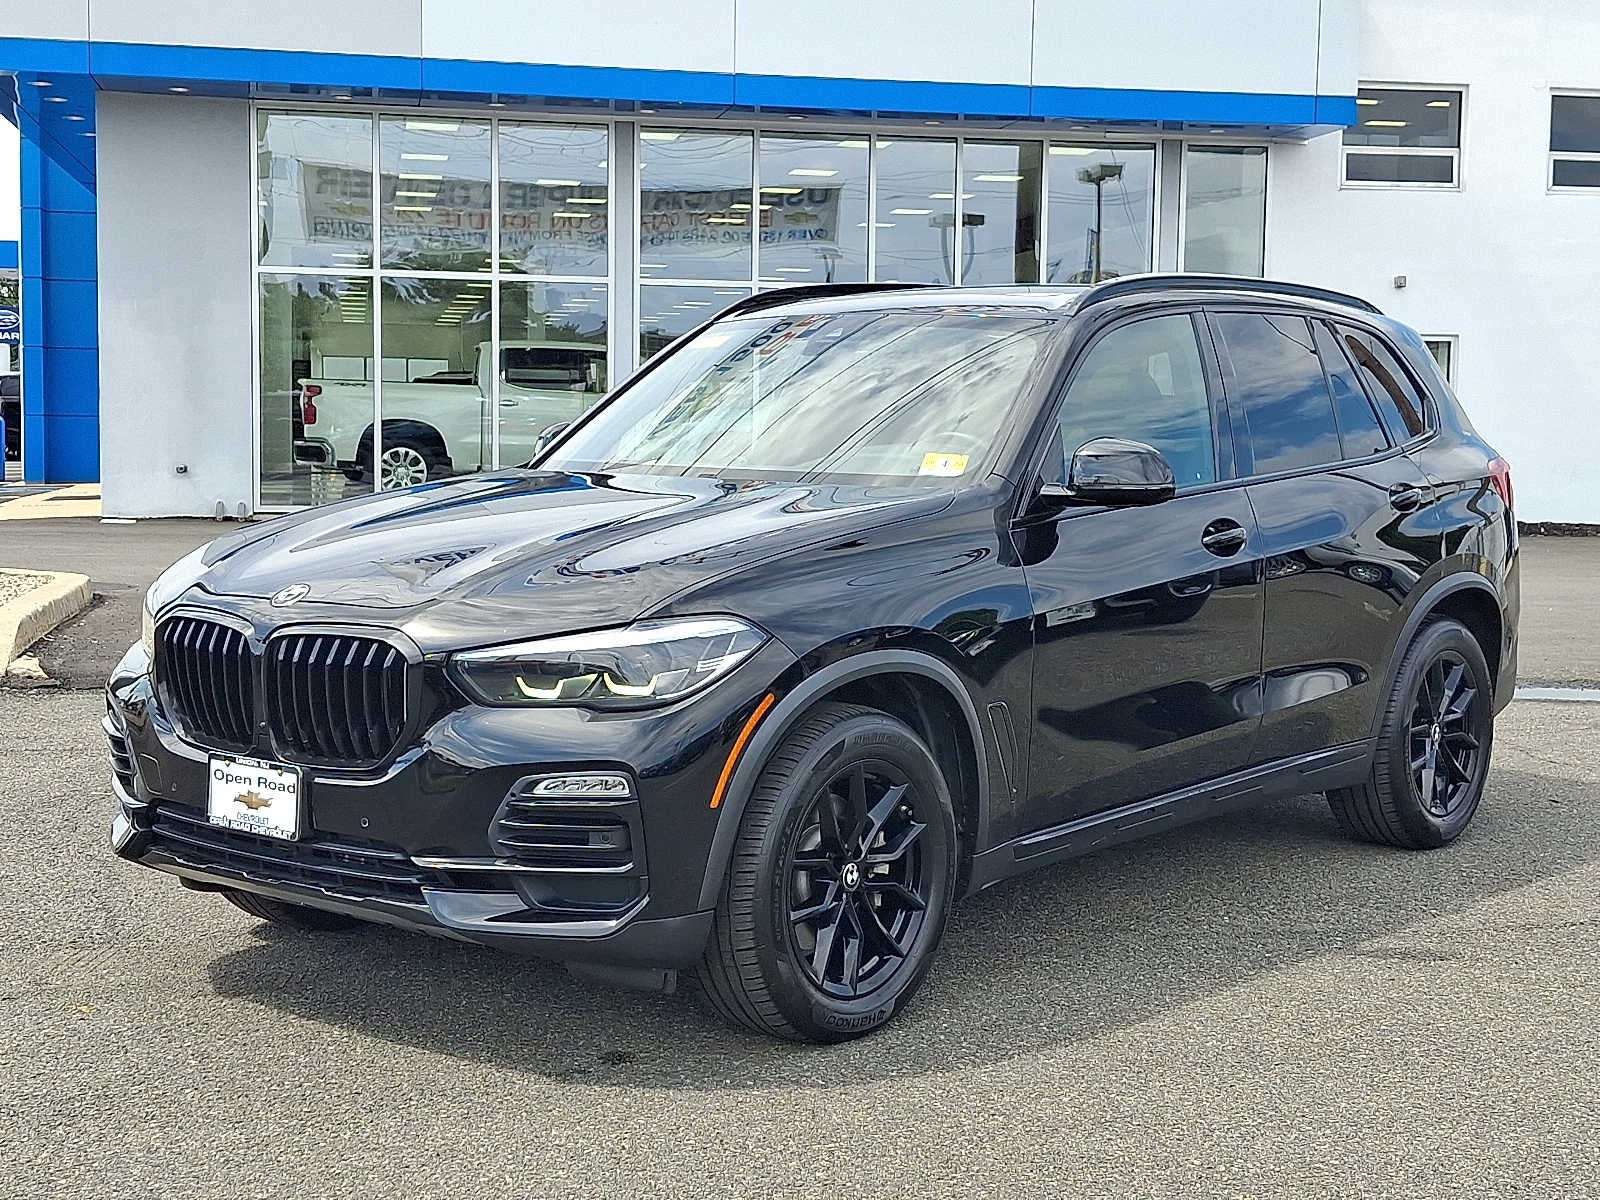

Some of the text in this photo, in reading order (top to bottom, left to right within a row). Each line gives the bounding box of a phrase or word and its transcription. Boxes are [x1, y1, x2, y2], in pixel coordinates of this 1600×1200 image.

[0, 331, 20, 340] AR
[214, 768, 296, 794] Open Road
[209, 815, 293, 840] OPEN ROAD CHEVROLET
[236, 811, 269, 825] CHEVROLET
